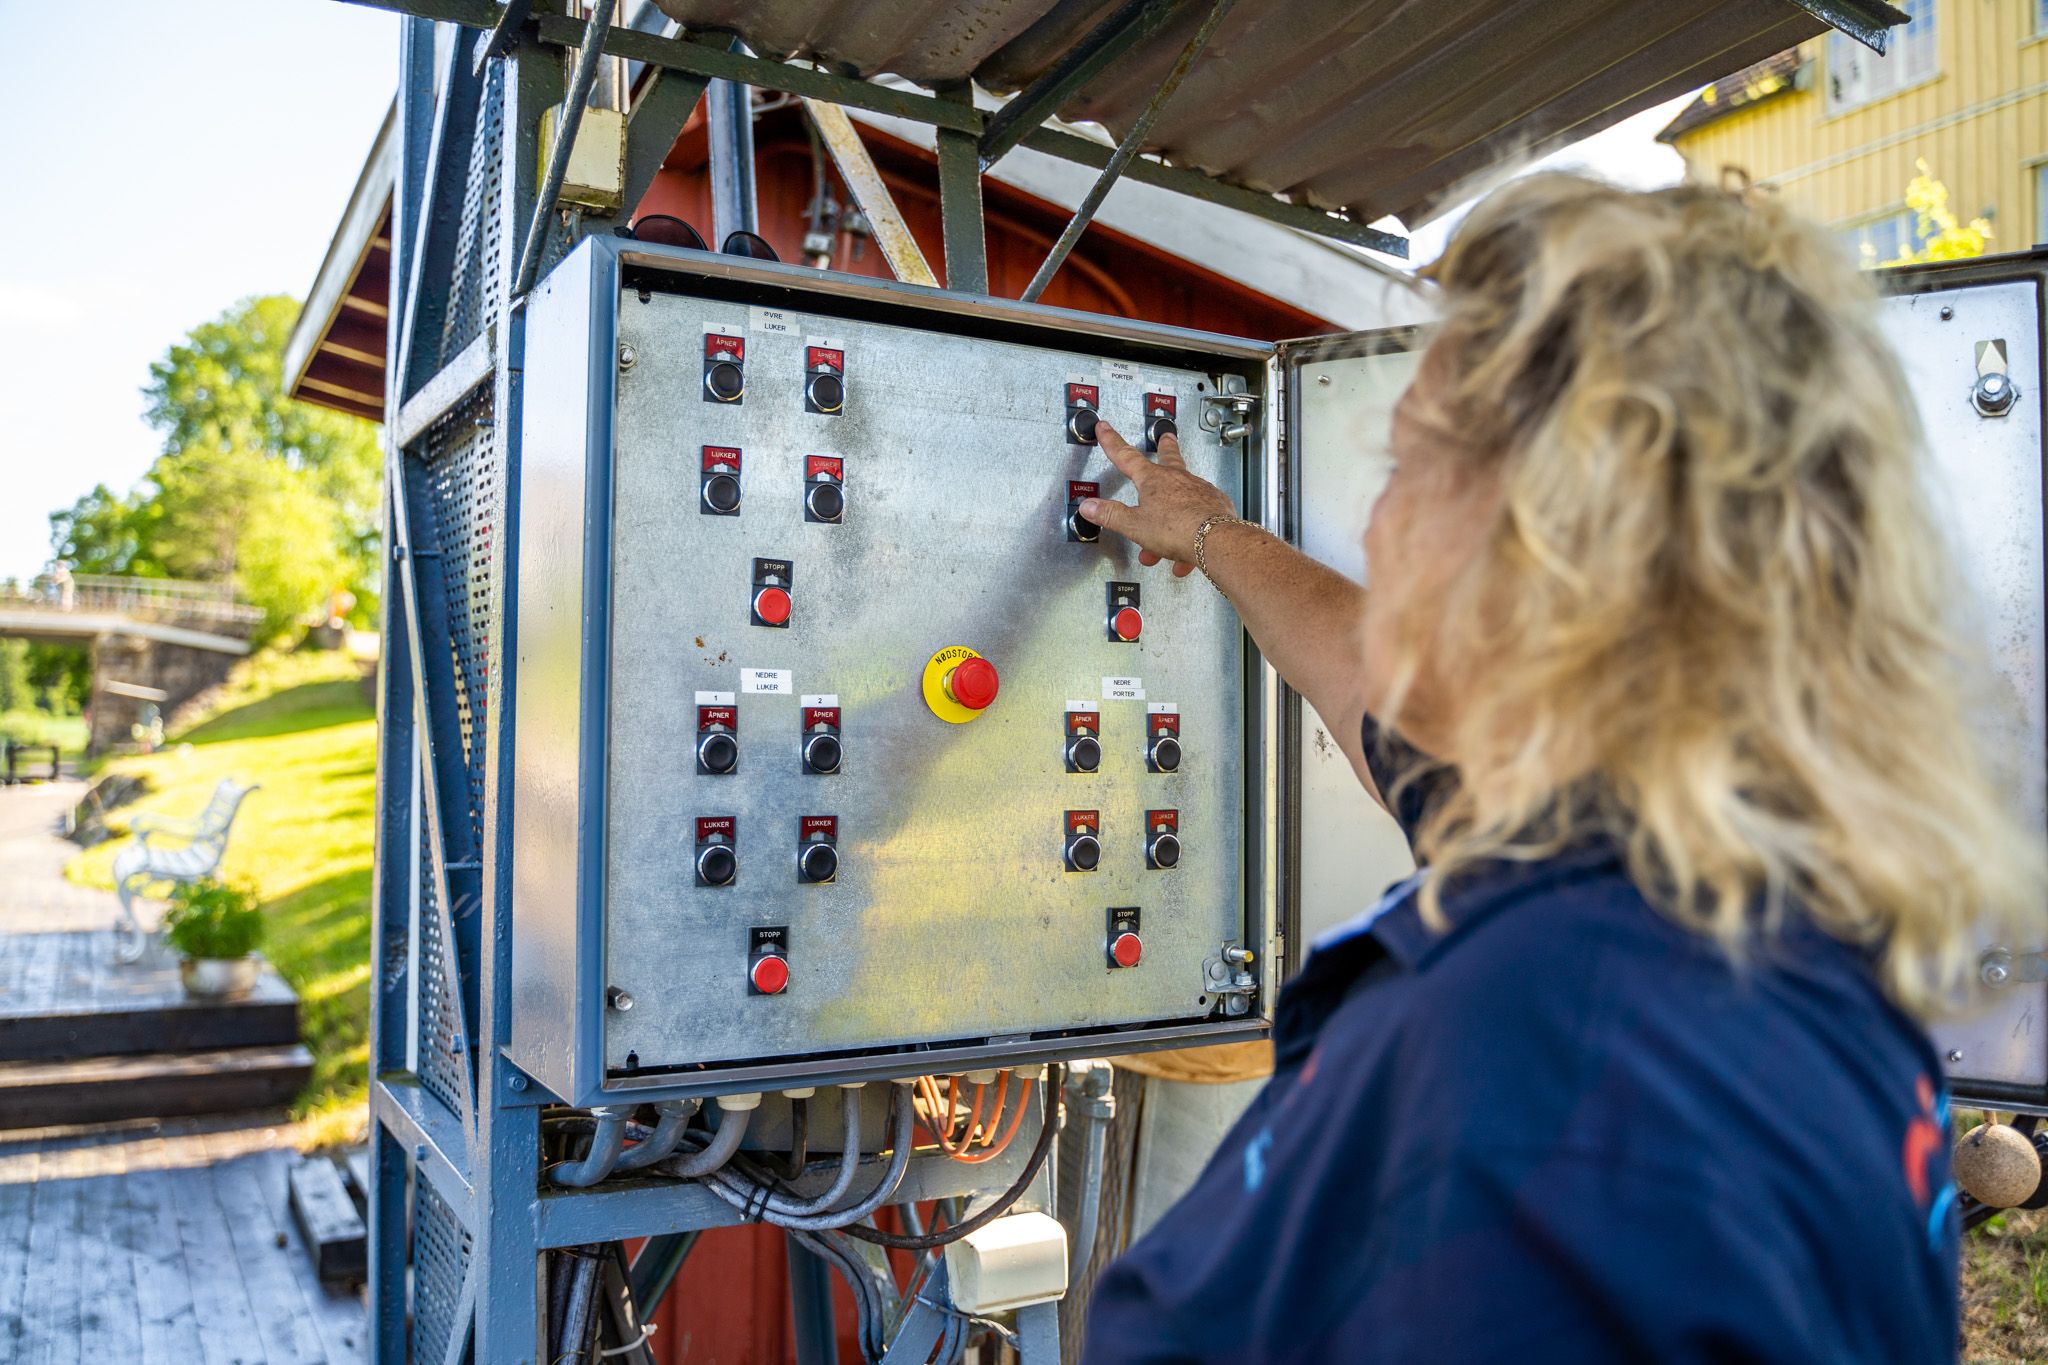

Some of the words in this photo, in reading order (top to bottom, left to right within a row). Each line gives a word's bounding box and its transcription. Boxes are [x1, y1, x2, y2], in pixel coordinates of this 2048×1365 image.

[764, 311, 783, 320] ØVRE
[764, 323, 786, 332] LUKER
[716, 337, 736, 347] ÅPNER
[817, 351, 836, 360] ÅPNER
[1113, 362, 1128, 370] ØVRE
[1076, 386, 1092, 395] ÅPNER
[1154, 396, 1170, 404] ÅPNER
[711, 451, 736, 459] LUKKER
[935, 649, 977, 665] NØDSTOP
[708, 710, 729, 719] ÅPNER
[813, 710, 834, 718] ÅPNER
